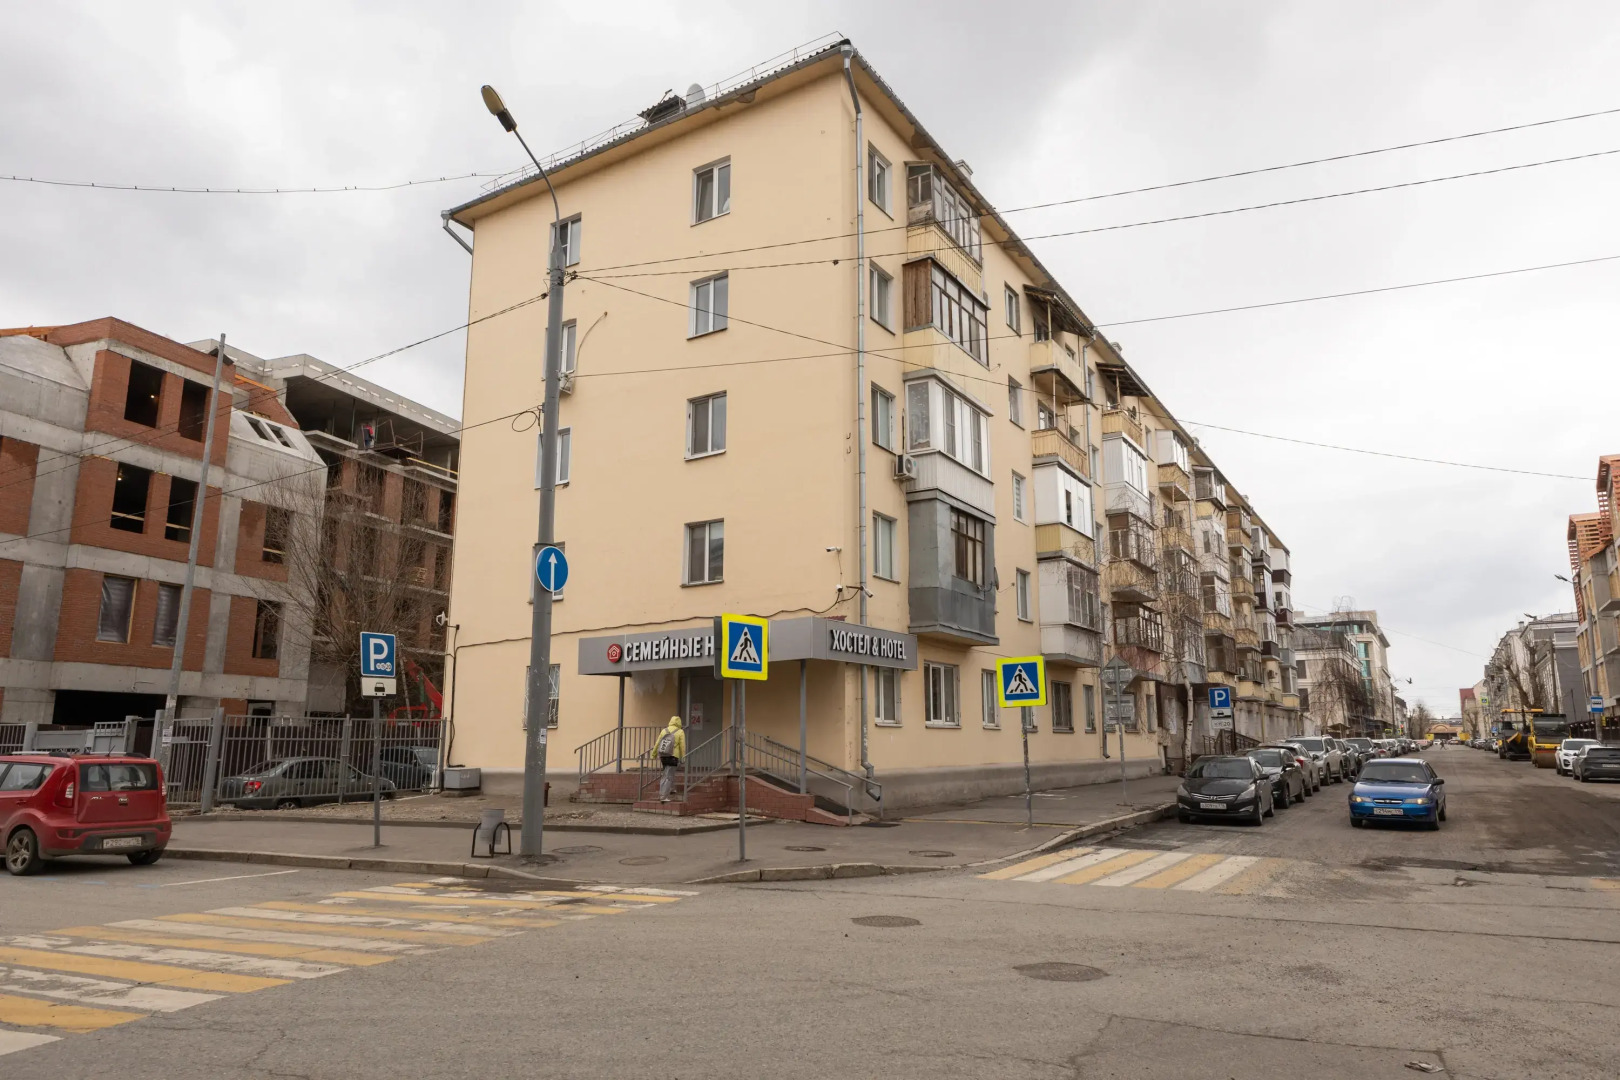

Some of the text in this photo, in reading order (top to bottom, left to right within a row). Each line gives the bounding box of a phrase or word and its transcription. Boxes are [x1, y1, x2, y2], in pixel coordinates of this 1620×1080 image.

[369, 637, 389, 671] P
[624, 635, 714, 663] СЕМЕЙНЫЕ Н
[831, 629, 907, 660] ХОСТЕЛ & HOTEL
[1214, 689, 1227, 707] P
[691, 715, 701, 725] 24
